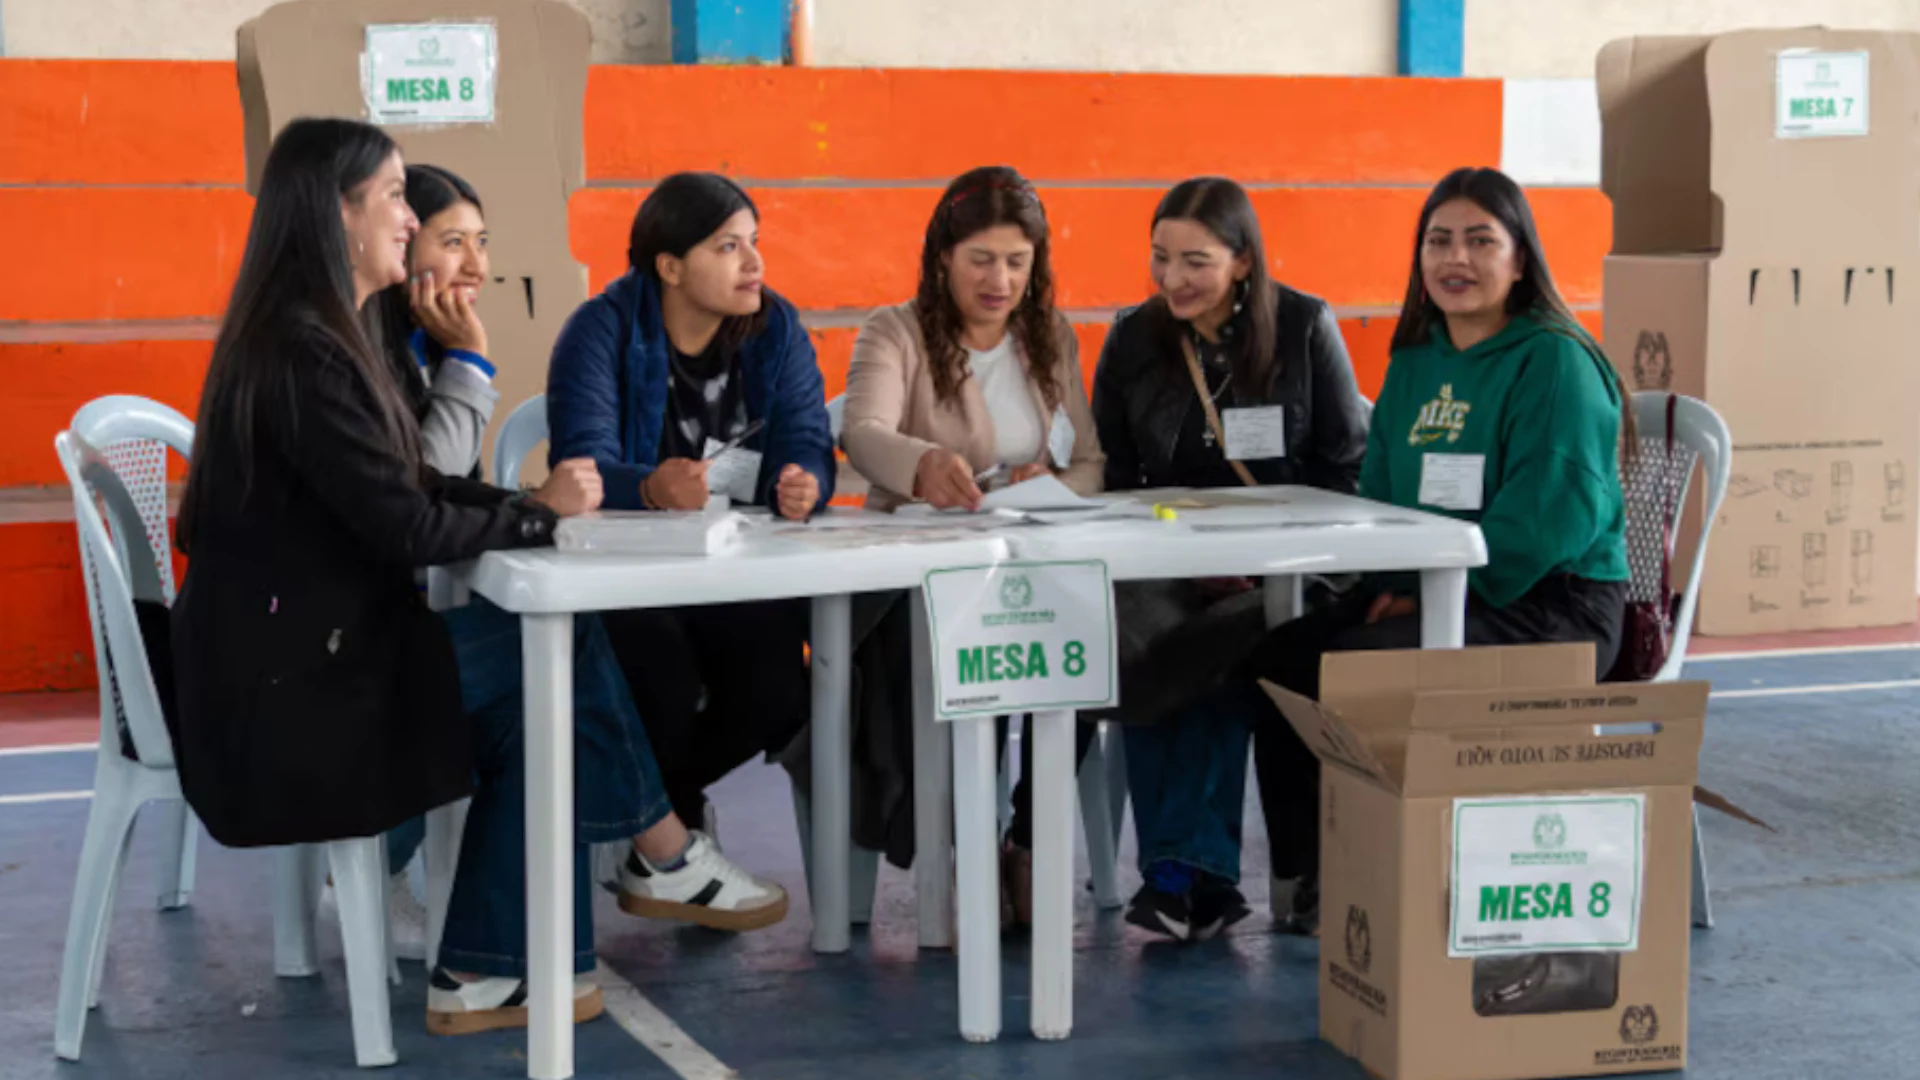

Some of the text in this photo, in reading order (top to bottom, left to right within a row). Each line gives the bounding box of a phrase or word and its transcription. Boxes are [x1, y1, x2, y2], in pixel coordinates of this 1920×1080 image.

[387, 77, 474, 102] MESA 8
[1790, 97, 1854, 117] MESA 7
[957, 640, 1087, 685] MESA 8
[1500, 747, 1545, 765] VOTO
[1550, 745, 1571, 763] SU
[1574, 740, 1656, 763] DEPOSITE
[1478, 881, 1612, 922] MESA 8
